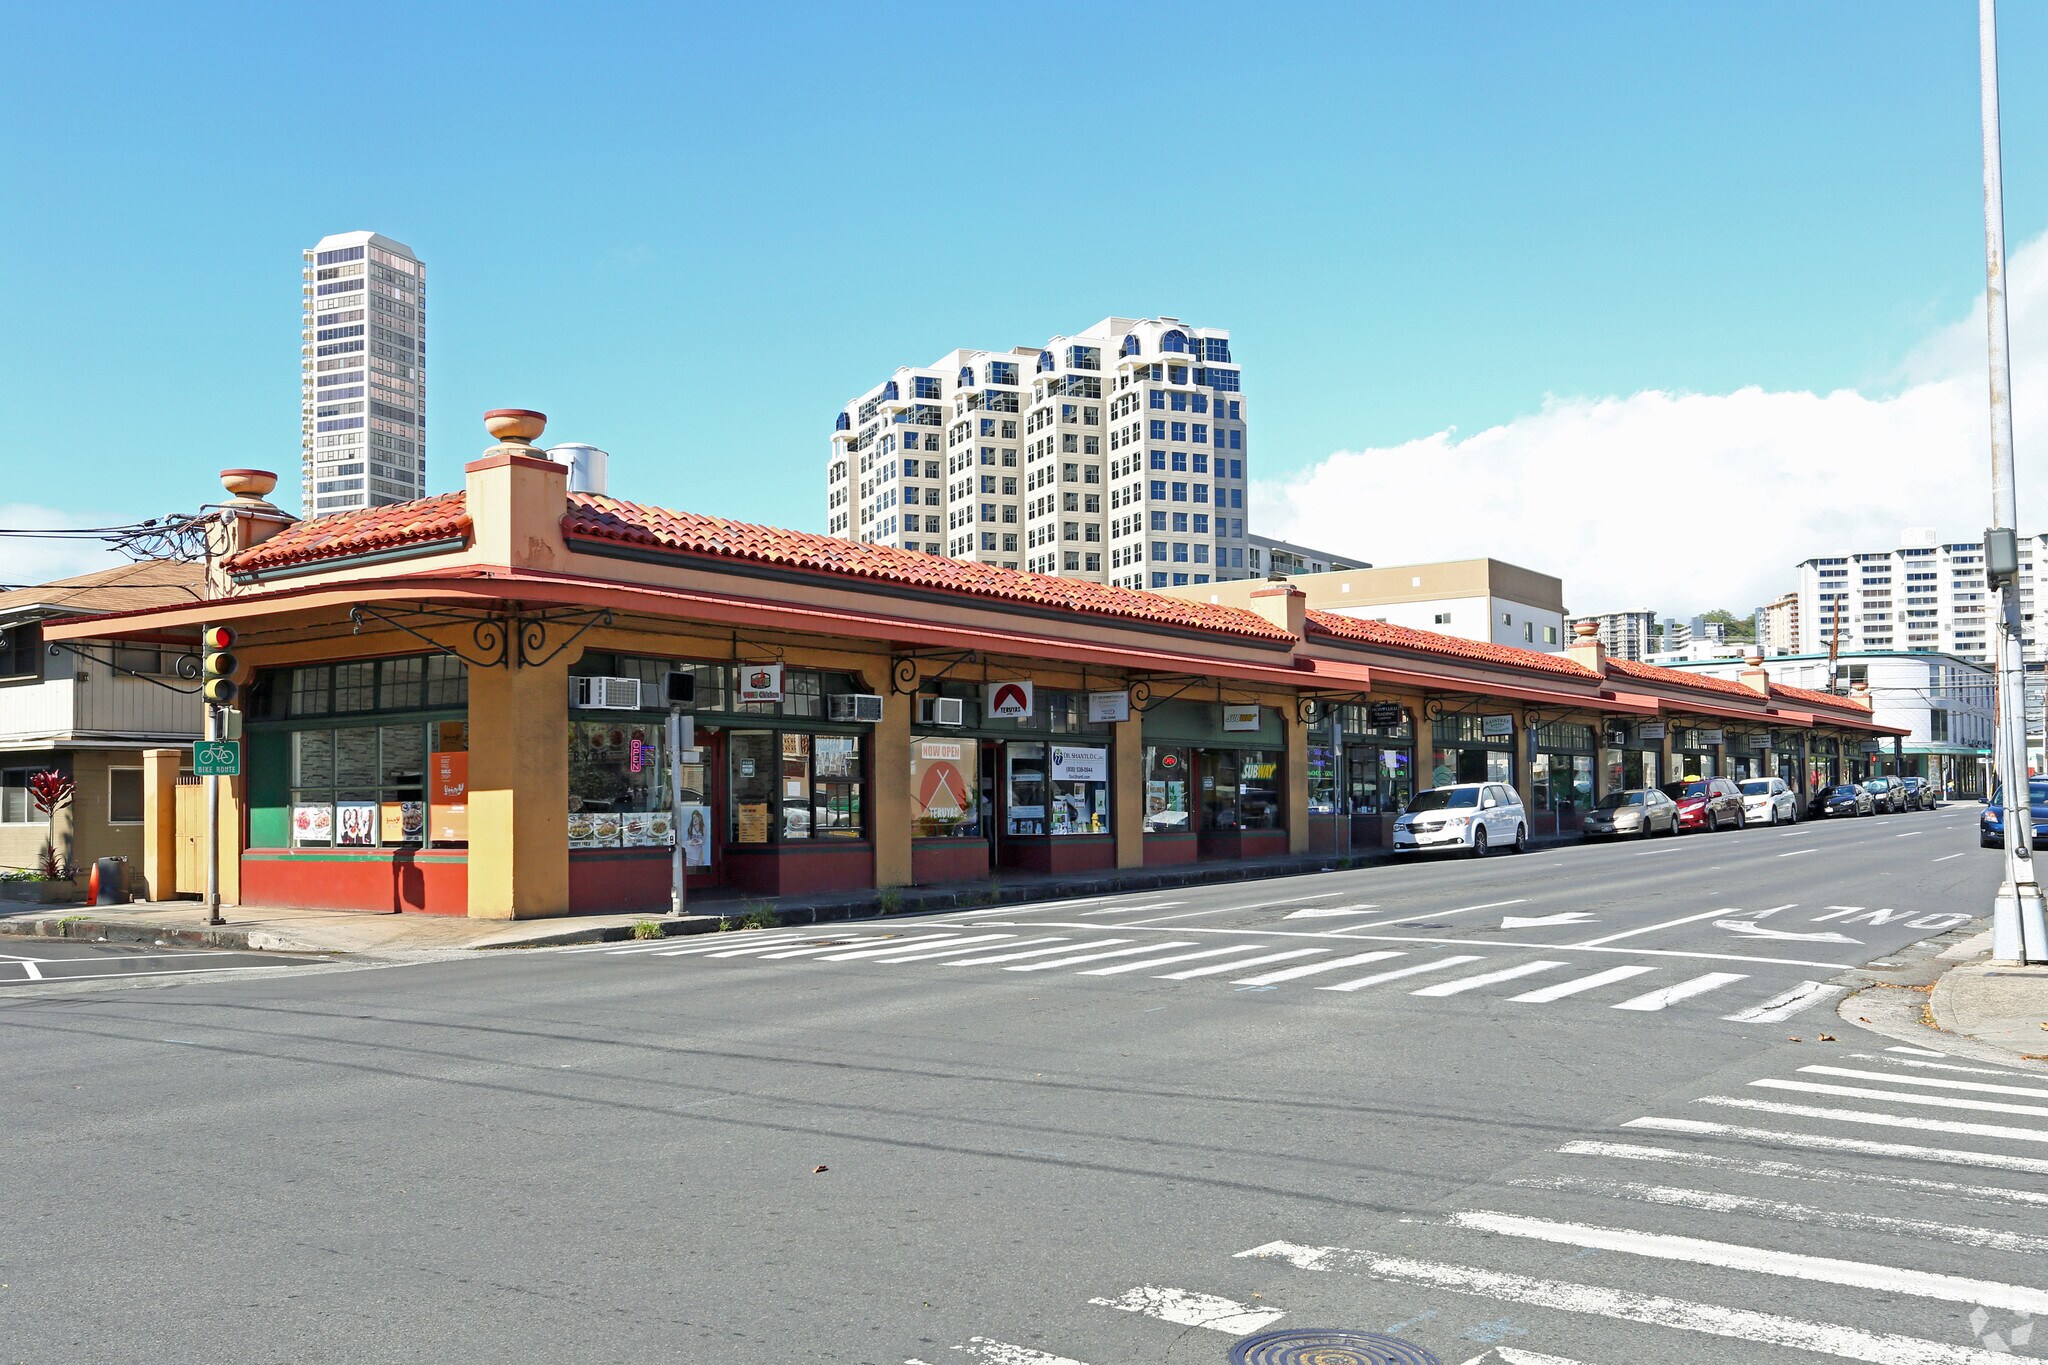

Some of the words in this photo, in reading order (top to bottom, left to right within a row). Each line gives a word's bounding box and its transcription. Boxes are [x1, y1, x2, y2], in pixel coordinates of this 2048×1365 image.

[1225, 713, 1258, 722] SUBWAY
[632, 741, 640, 771] OPEN
[923, 745, 940, 757] NOW
[942, 746, 960, 757] OPEN
[1242, 762, 1277, 779] SUBWAY
[929, 807, 959, 819] TERUYAS
